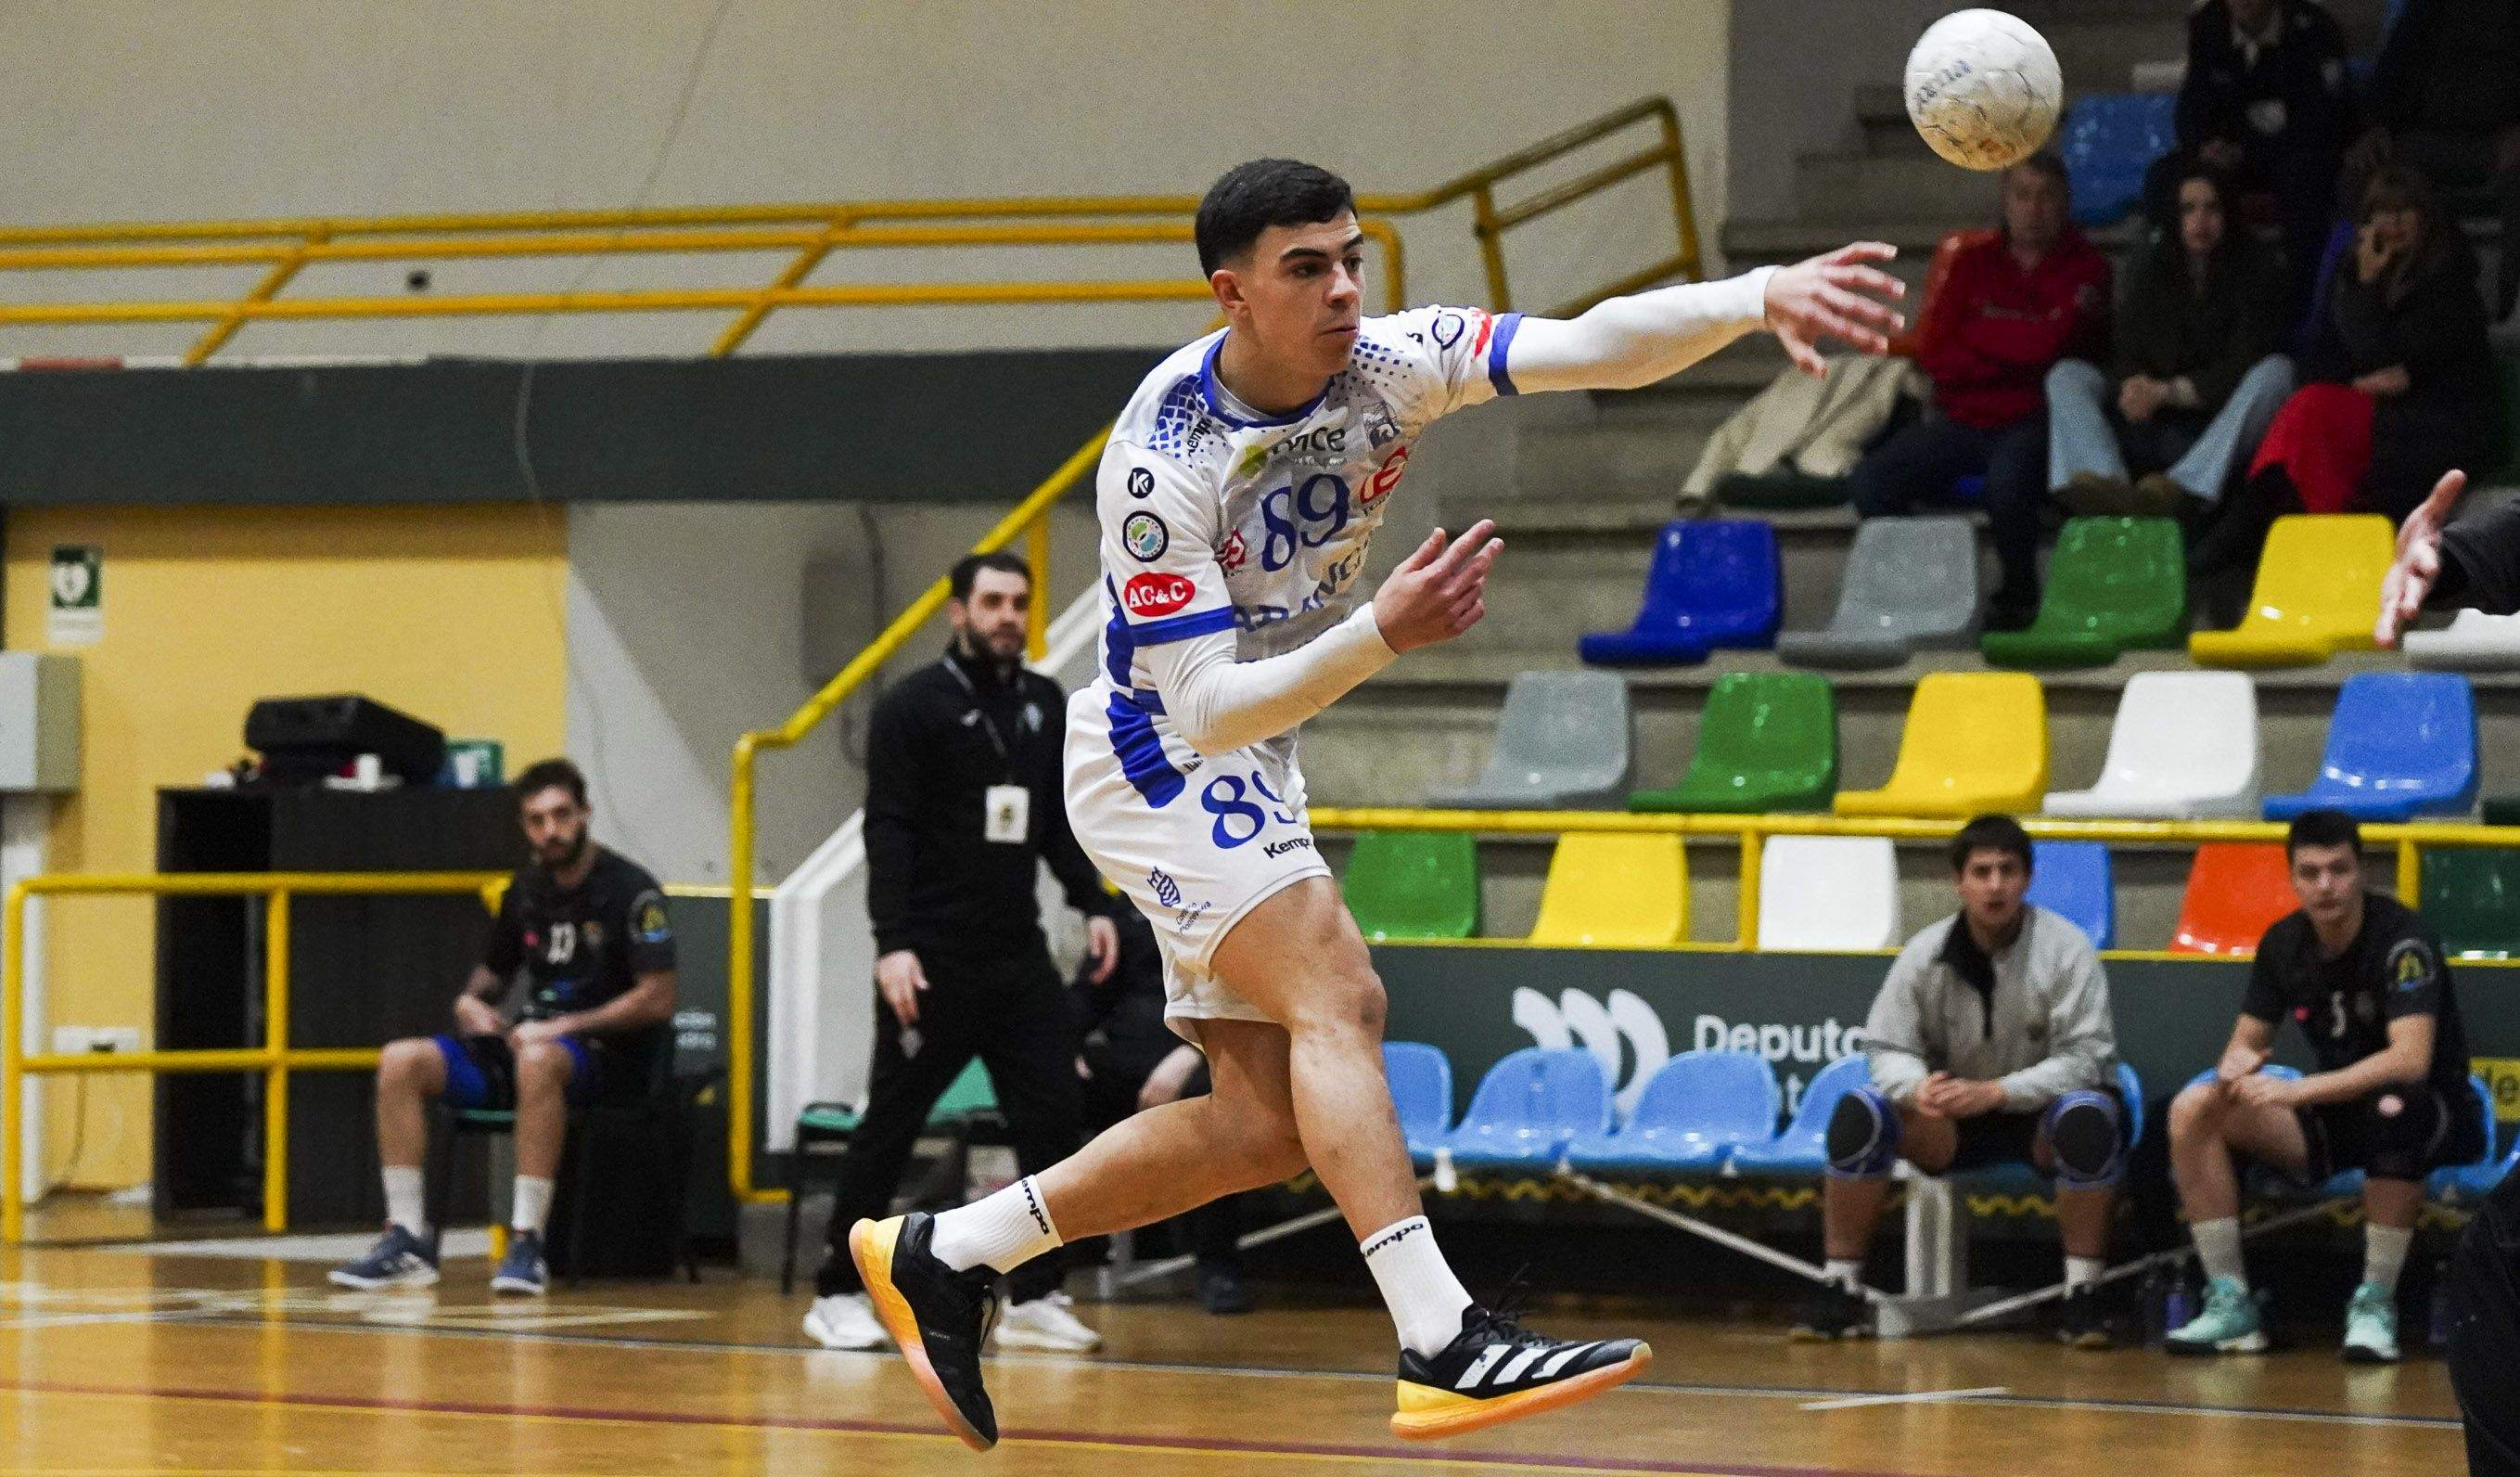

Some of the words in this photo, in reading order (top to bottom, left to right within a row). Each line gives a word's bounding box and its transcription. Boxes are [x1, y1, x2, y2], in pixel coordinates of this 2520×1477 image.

[1260, 473, 1350, 572] 89
[1129, 581, 1186, 609] AC&C
[1262, 837, 1311, 859] Kemp
[1021, 1179, 1050, 1235] empa
[1362, 1223, 1424, 1258] empa
